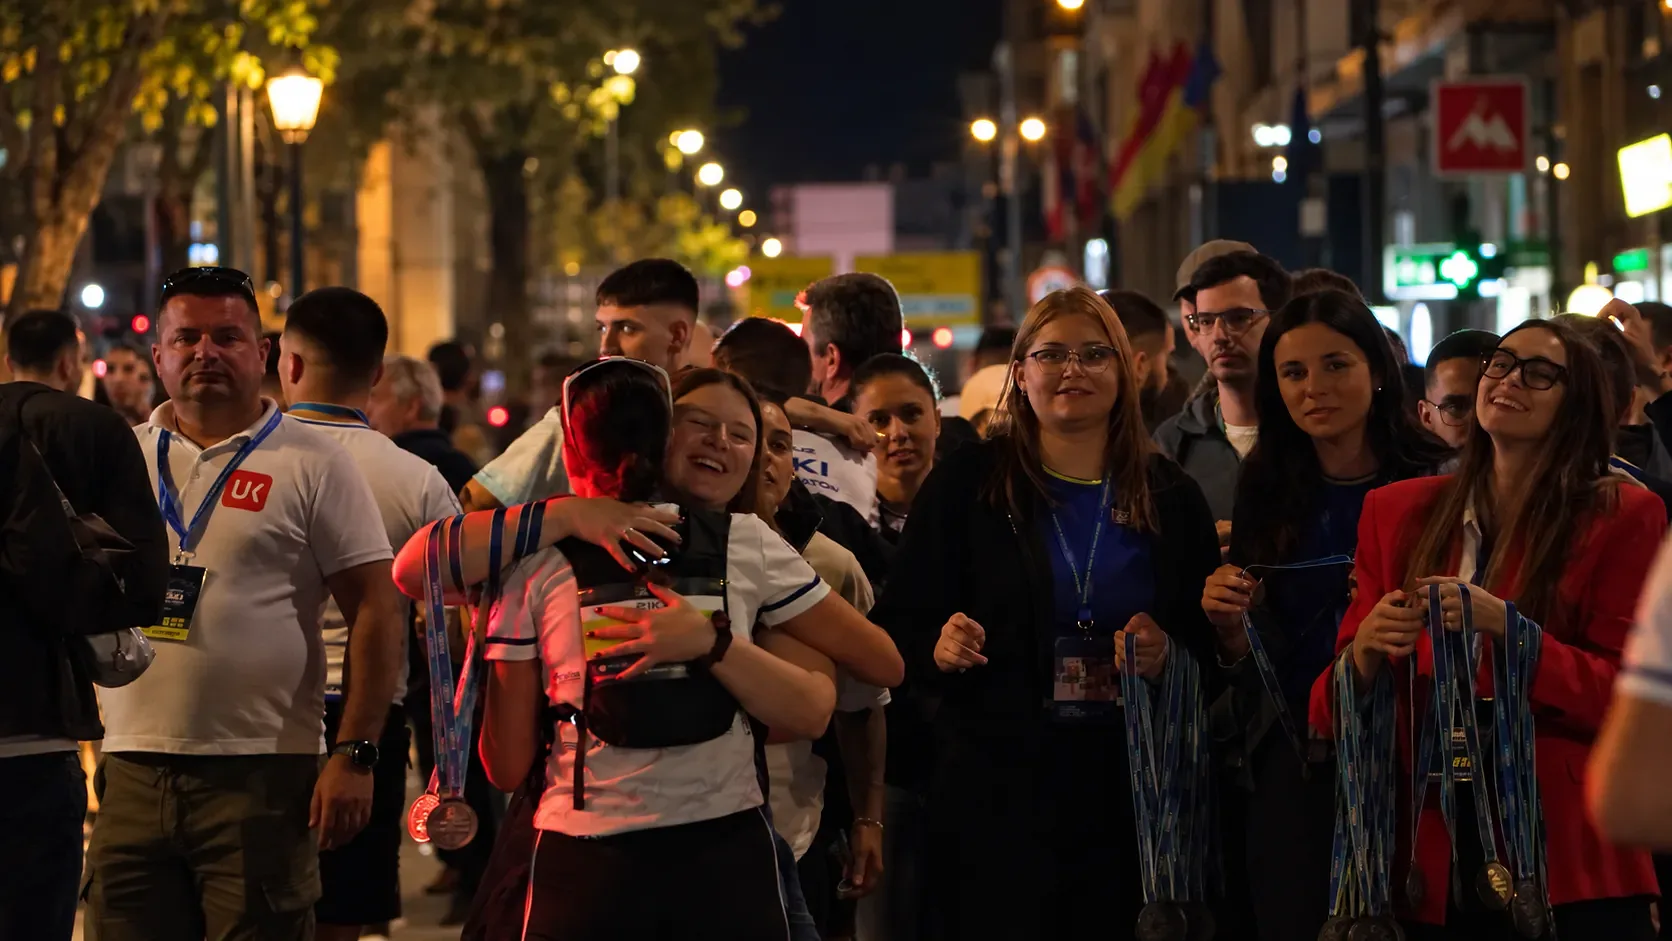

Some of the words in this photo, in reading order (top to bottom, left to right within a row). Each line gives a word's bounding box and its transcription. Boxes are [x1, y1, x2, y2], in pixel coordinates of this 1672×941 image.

[792, 457, 828, 477] KI
[231, 479, 265, 503] UK
[802, 478, 839, 493] ATON
